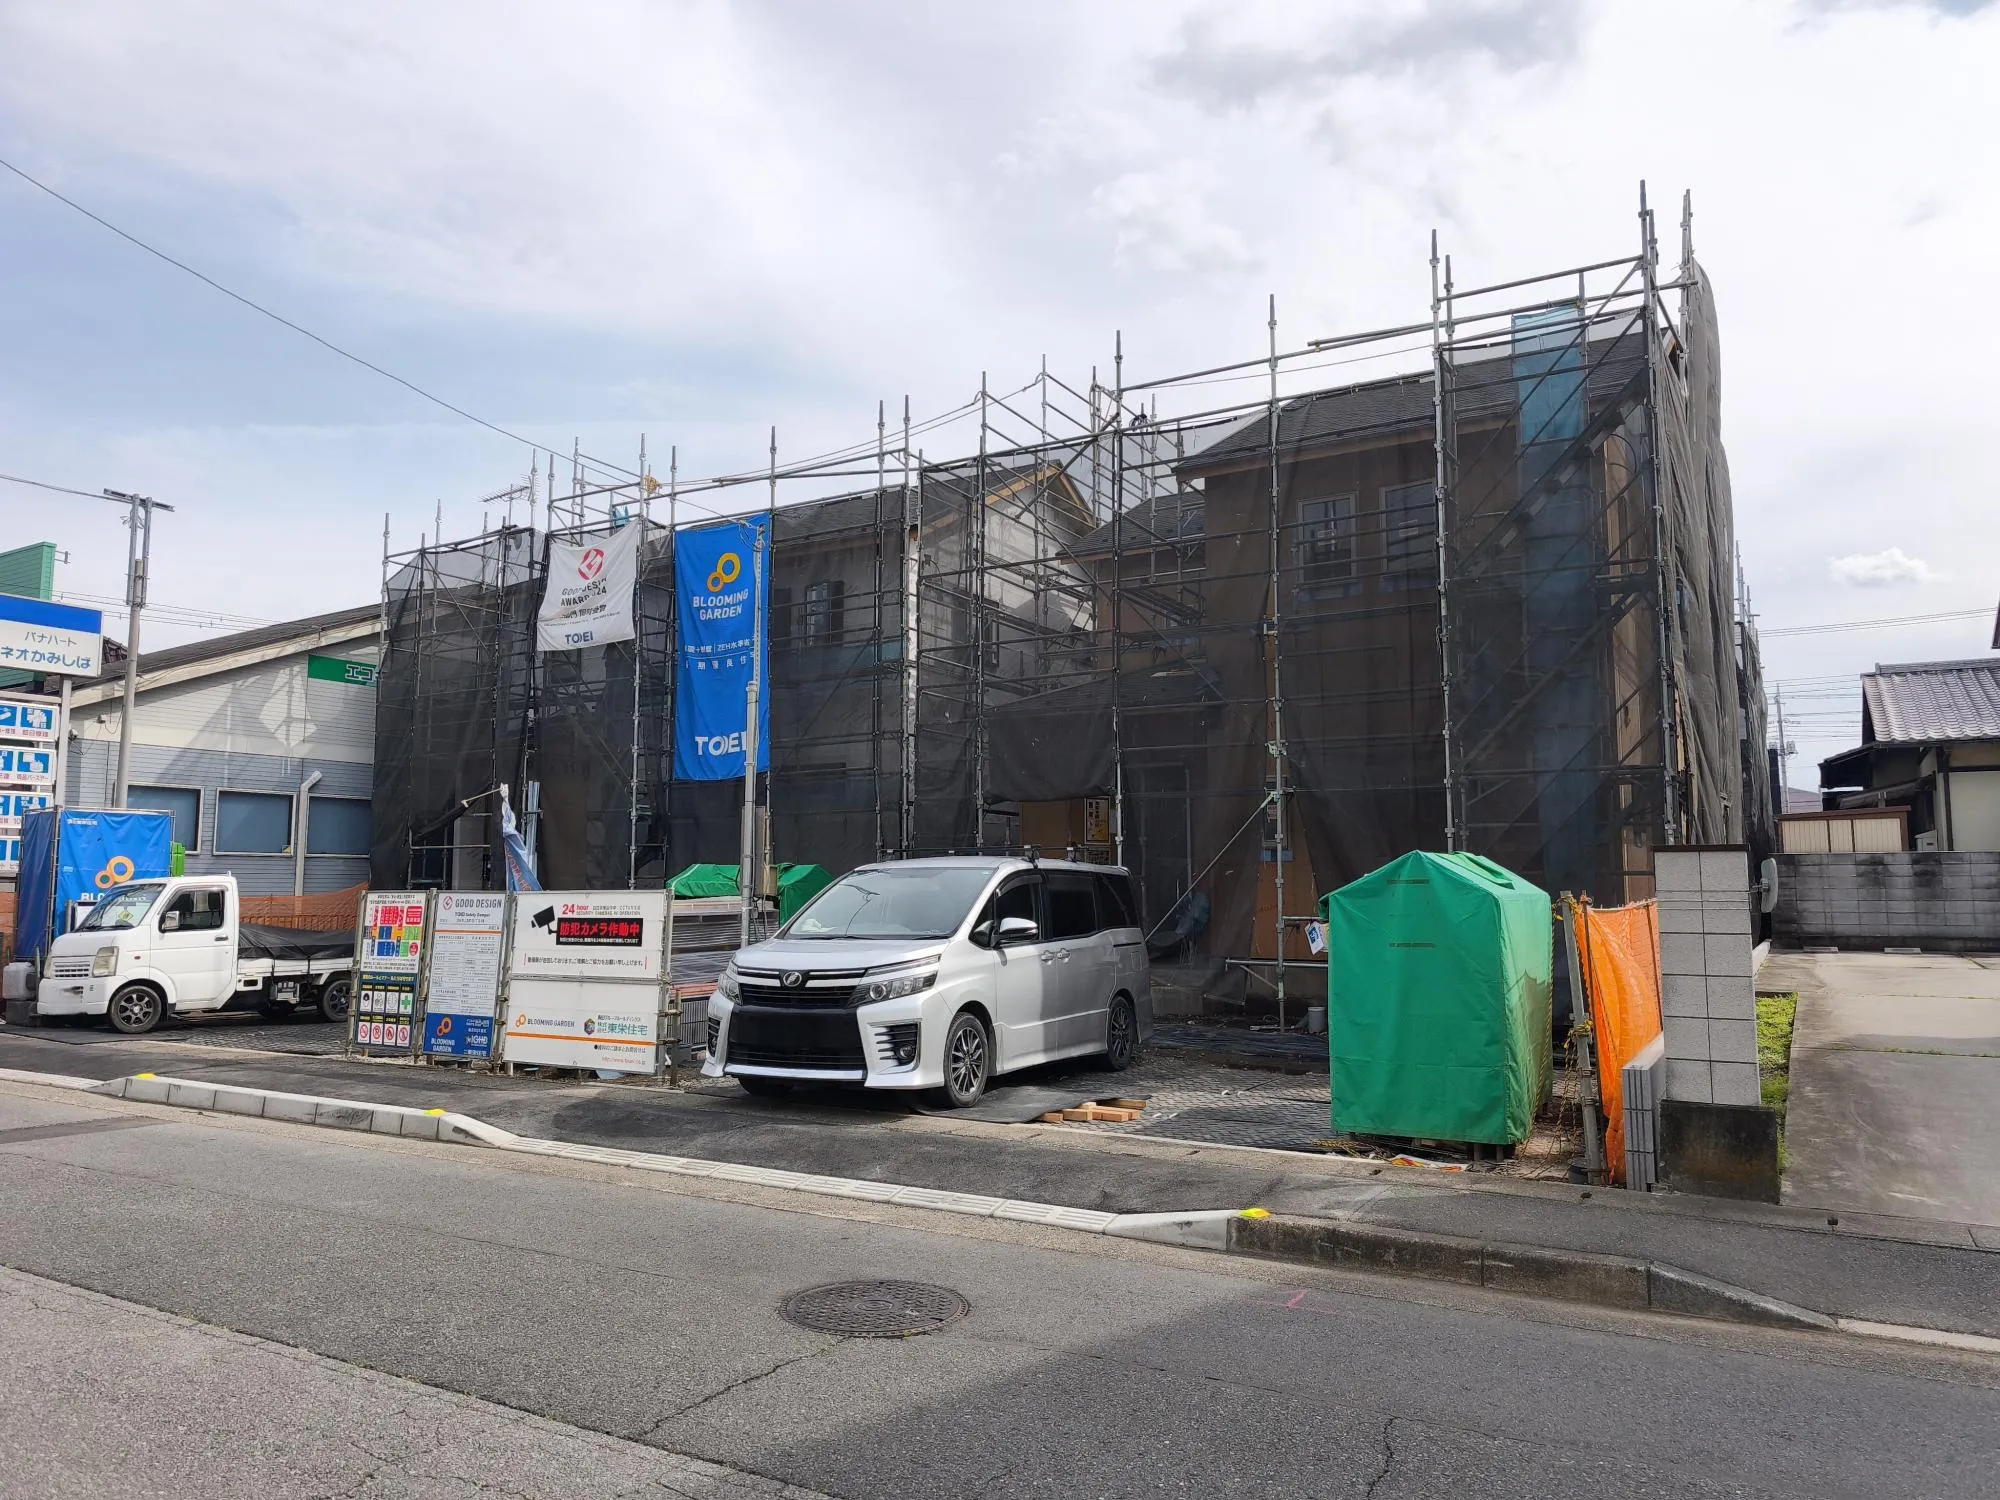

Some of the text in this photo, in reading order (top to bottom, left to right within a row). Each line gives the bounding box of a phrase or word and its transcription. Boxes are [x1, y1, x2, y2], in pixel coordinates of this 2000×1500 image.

[693, 588, 749, 608] BLOOMING
[700, 604, 742, 621] GARDEN
[564, 631, 594, 645] TOEI
[0, 645, 91, 669] ネオかみしば
[345, 664, 379, 682] エコ
[695, 731, 747, 756] TOEI
[455, 898, 502, 909] GOOD DESIGN
[562, 903, 576, 916] 24
[560, 921, 640, 937] 防犯カメラ作動中
[527, 1018, 575, 1027] BLOOMING GARDEN
[607, 1023, 648, 1036] 東栄住宅
[430, 1037, 456, 1046] BLOOMING
[432, 1045, 452, 1053] GARDEN
